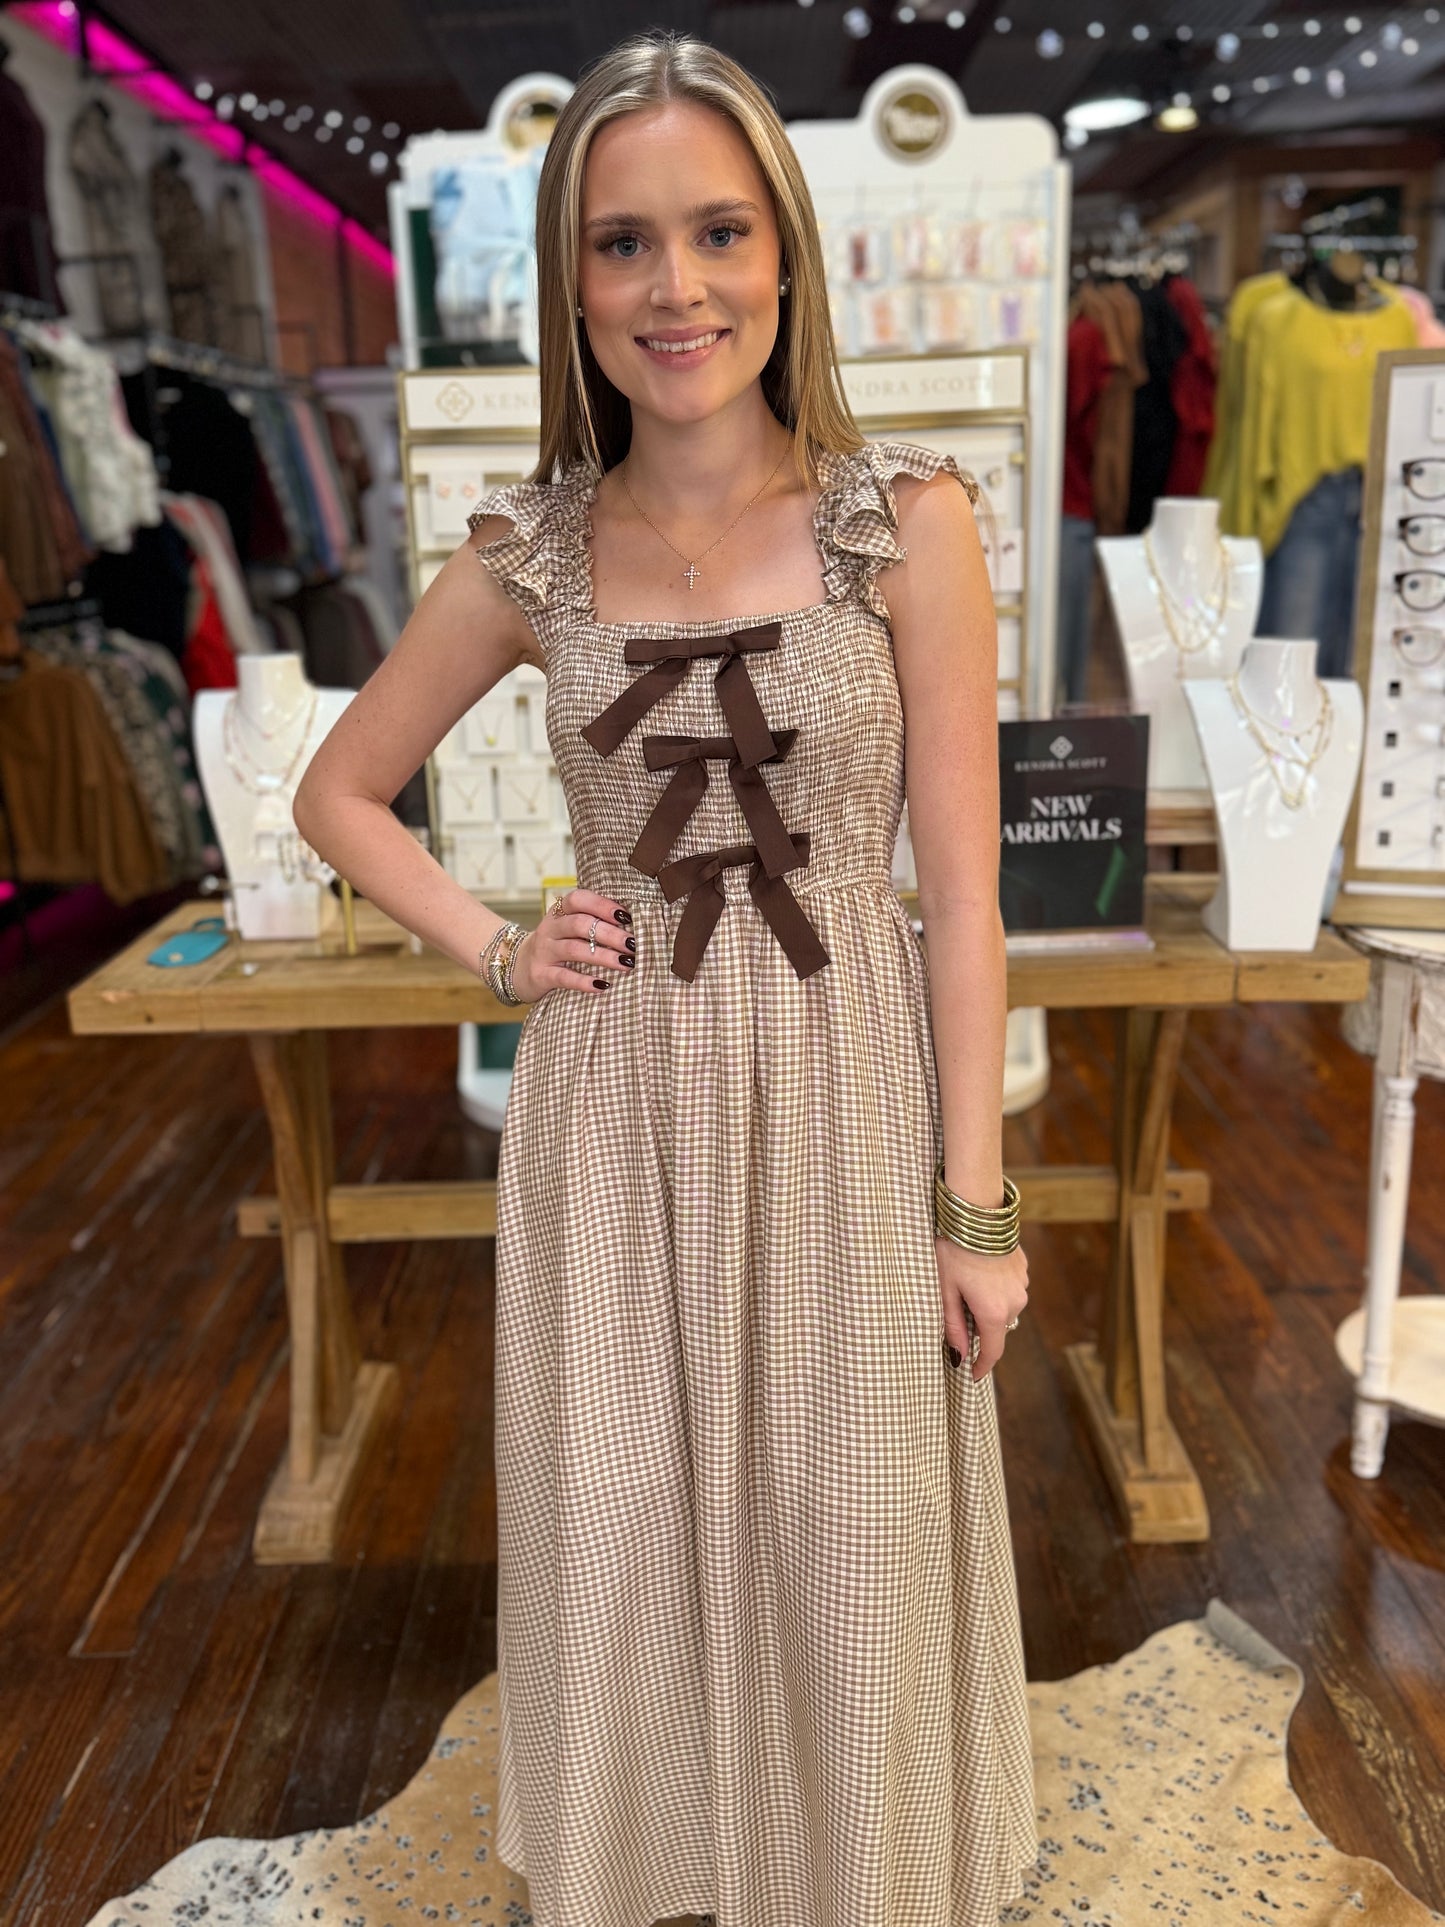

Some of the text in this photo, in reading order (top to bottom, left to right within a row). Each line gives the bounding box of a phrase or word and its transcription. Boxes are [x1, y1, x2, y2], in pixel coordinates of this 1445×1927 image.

[1014, 757, 1107, 772] KENDRA SCOTT
[1030, 794, 1092, 819] NEW
[1000, 818, 1122, 844] ARRIVALS
